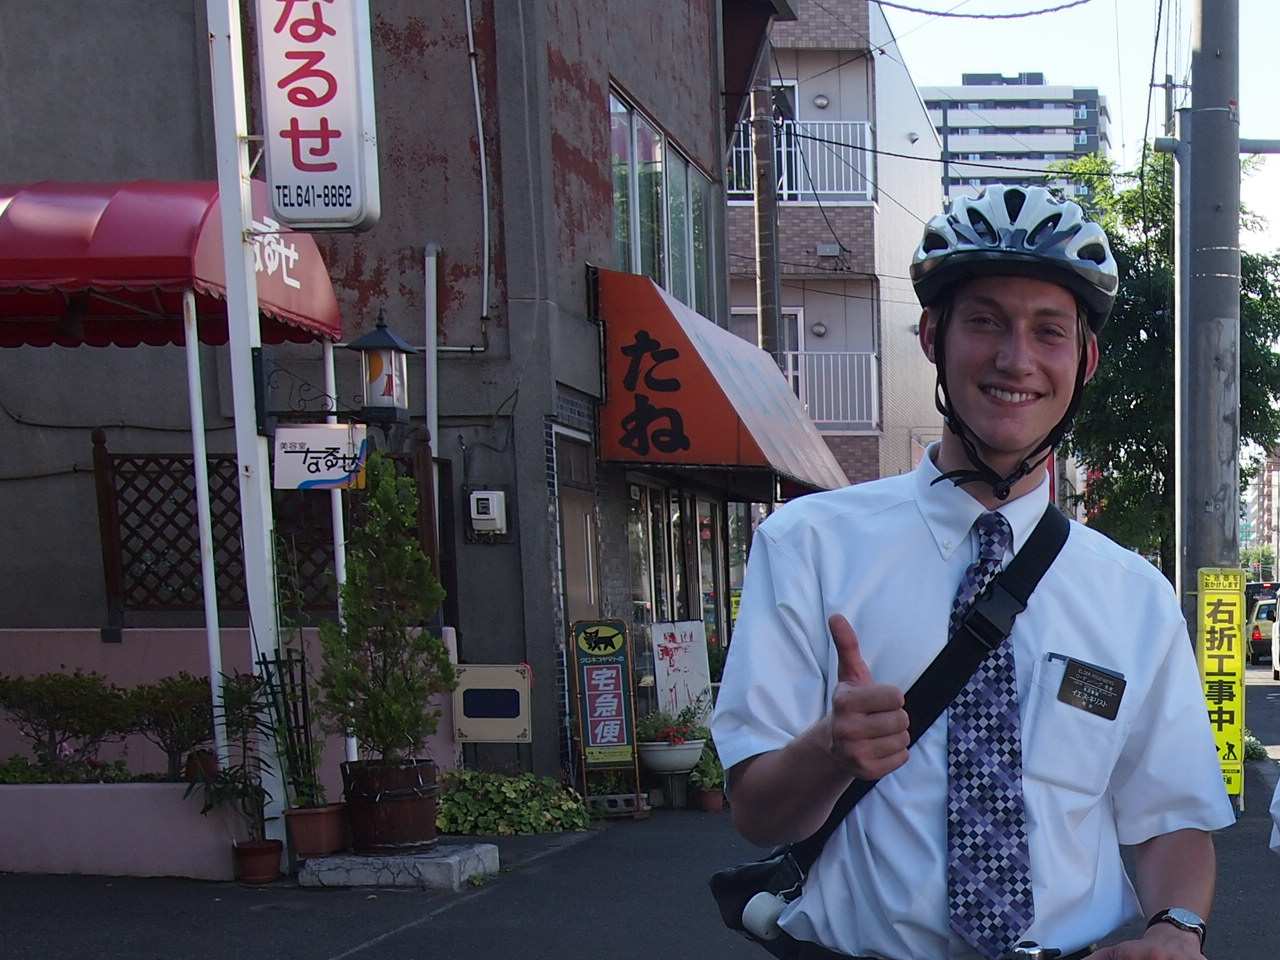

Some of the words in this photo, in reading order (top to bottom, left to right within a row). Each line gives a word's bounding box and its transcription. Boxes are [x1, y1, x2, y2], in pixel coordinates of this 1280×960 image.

[275, 185, 295, 208] TEL
[296, 185, 352, 208] 641-8862
[617, 329, 691, 456] たね
[591, 667, 621, 744] 宅急便
[1205, 598, 1237, 732] 右折工事中
